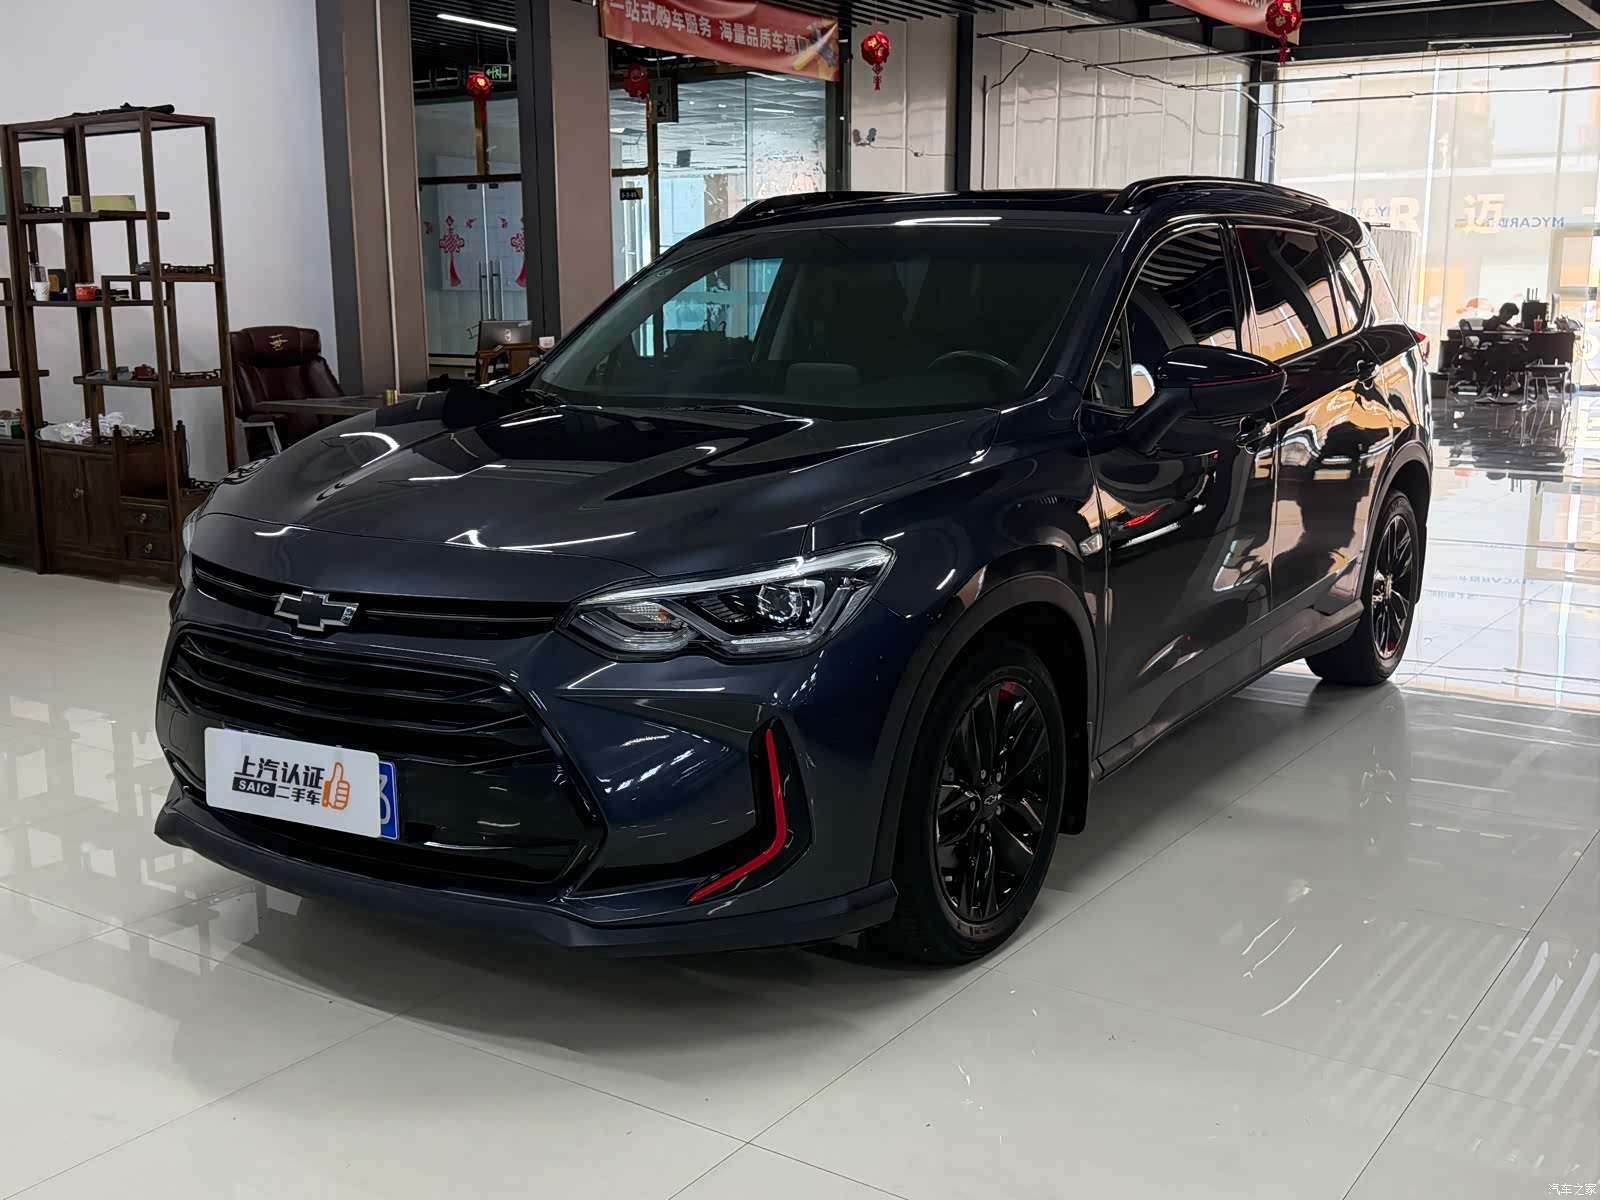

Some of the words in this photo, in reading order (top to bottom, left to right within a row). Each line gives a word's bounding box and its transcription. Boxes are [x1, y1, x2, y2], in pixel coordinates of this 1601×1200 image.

[609, 0, 712, 38] 一站式购车服务
[719, 19, 797, 56] 海量品质车源
[234, 755, 325, 789] 上汽认证
[238, 779, 270, 795] SAIC
[275, 785, 322, 806] 二手车
